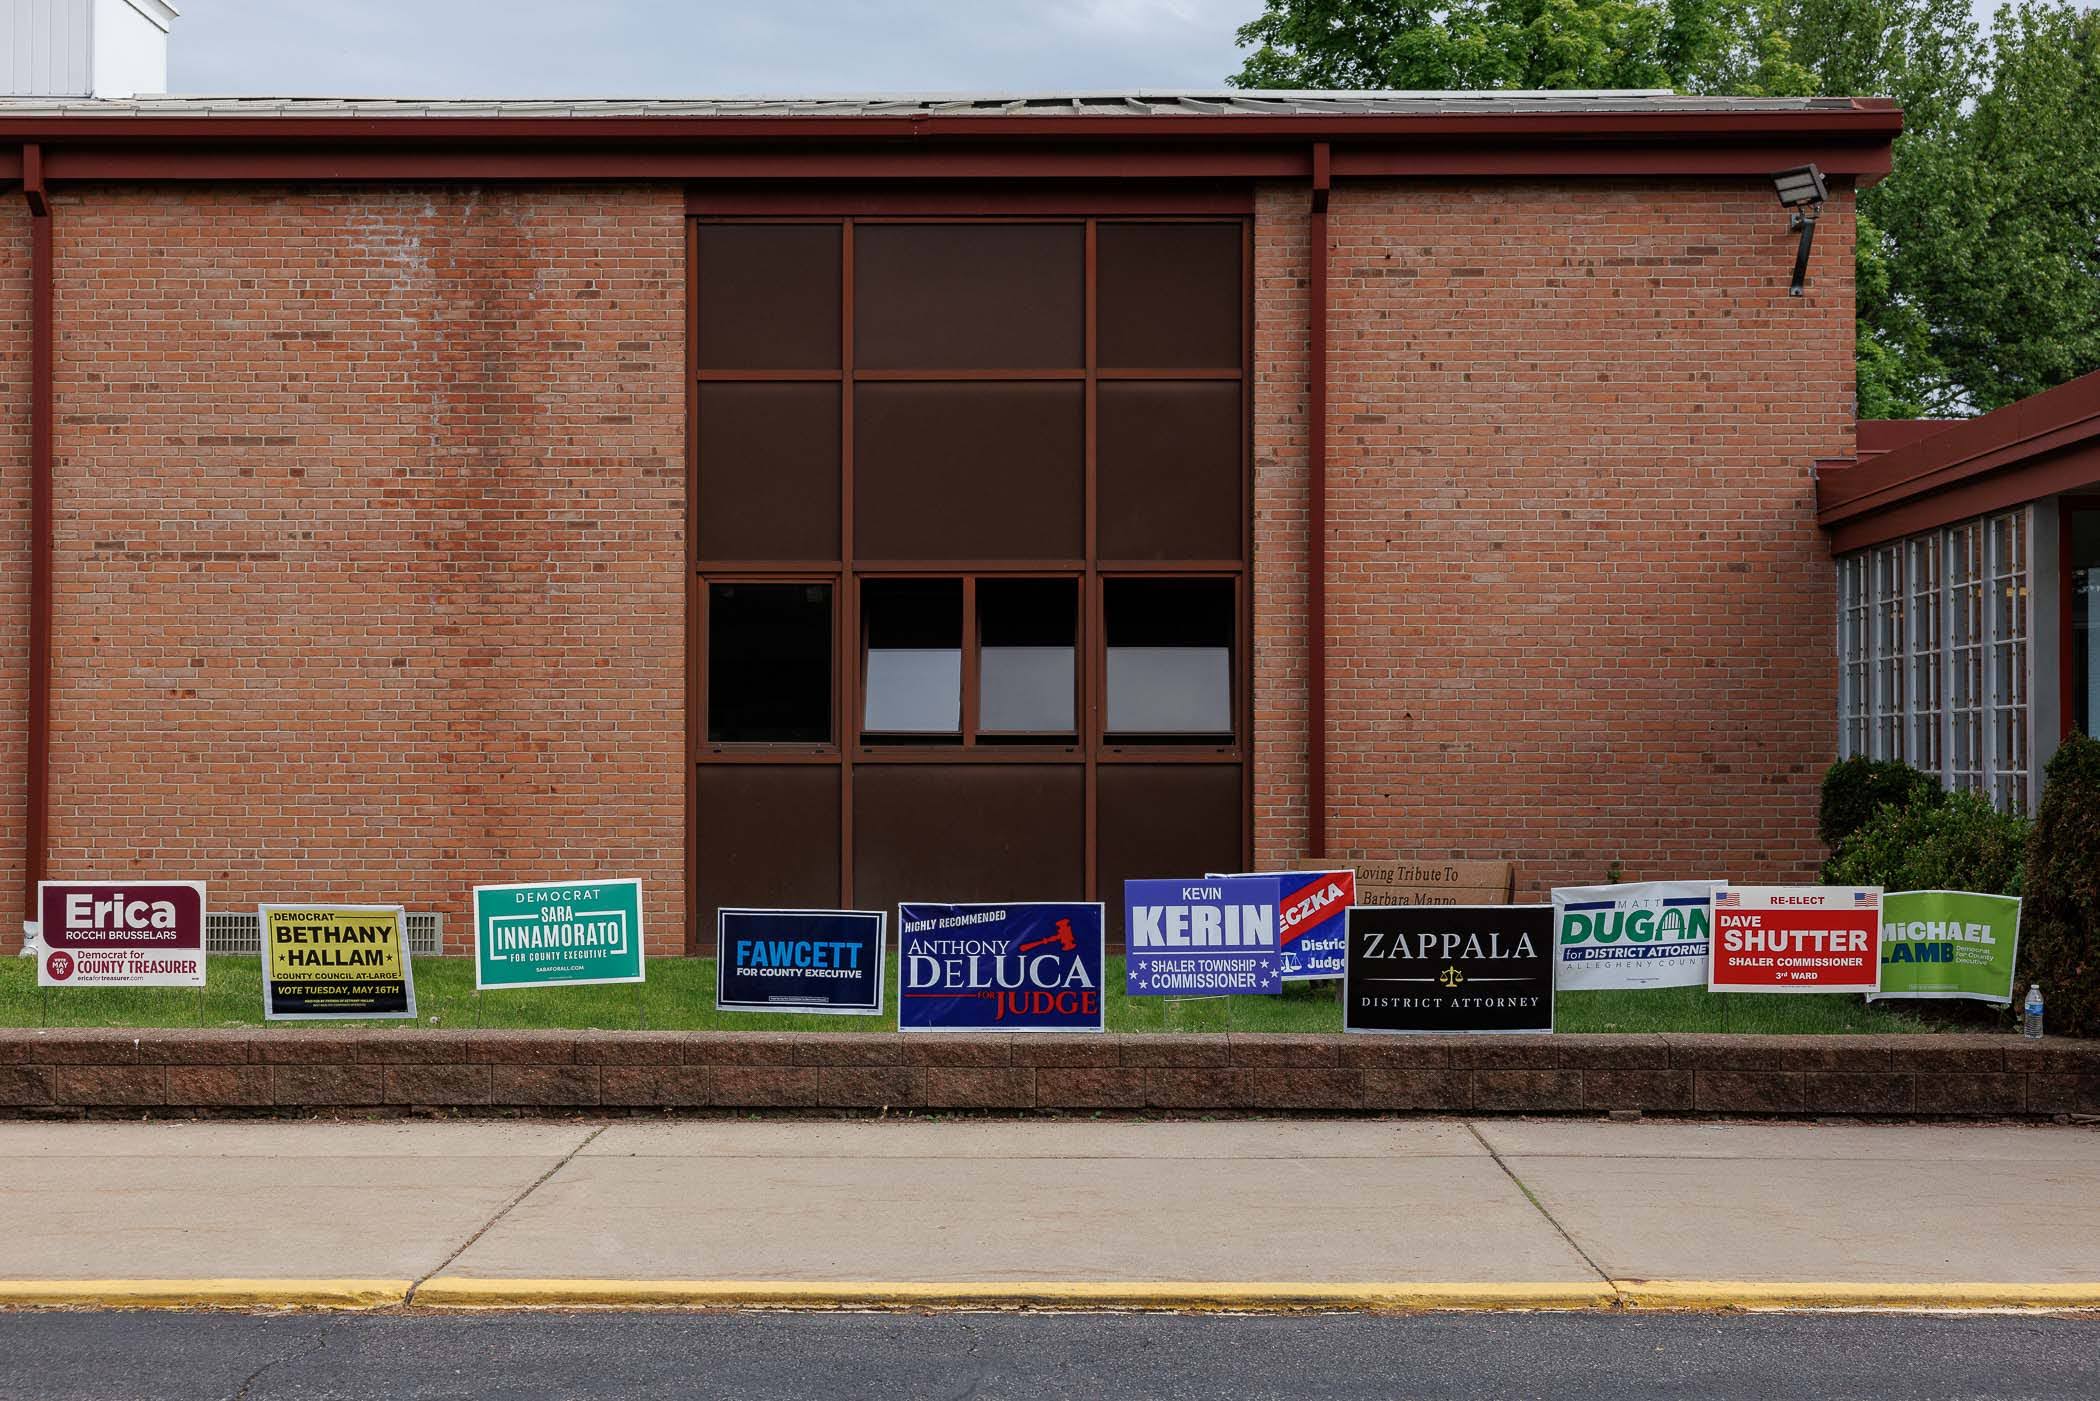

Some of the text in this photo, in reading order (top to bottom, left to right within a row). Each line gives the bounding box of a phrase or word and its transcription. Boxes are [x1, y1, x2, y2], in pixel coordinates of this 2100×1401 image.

[1356, 866, 1458, 883] Loving Tribute To
[516, 889, 600, 903] DEMOCRAT
[1182, 887, 1222, 900] KEVIN
[1364, 892, 1409, 905] Barbara
[1770, 896, 1825, 905] RE-ELECT
[66, 894, 176, 928] Erica
[1618, 899, 1661, 909] MATT
[274, 913, 335, 922] DEMOCRAT
[541, 906, 573, 922] SARA
[1720, 915, 1761, 927] DAVE
[905, 910, 1006, 933] HIGHLY RECOMMENDED
[1132, 904, 1273, 946] KERIN
[1560, 908, 1710, 945] DUGAN
[66, 931, 176, 940] ROCCHI BRUSSELARS
[276, 926, 392, 944] BETHANY
[497, 922, 618, 950] INNAMORATO
[1723, 929, 1868, 952] SHUTTER
[908, 938, 1010, 954] ANTHONY
[1301, 938, 1345, 951] Distric
[1363, 932, 1538, 959] ZAPPALA
[1956, 946, 1990, 954] Democrat
[78, 951, 144, 959] Democrat for
[288, 950, 384, 966] HALLAM
[510, 949, 607, 962] FOR COUNTY EXECUTIVE
[736, 940, 863, 968] FAWCETT
[1566, 945, 1709, 960] for DISTRICT ATTORNE
[1968, 952, 1994, 961] County
[78, 960, 197, 974] COUNTY TREASURER
[1151, 959, 1256, 973] SHALER TOWNSHIP
[1566, 958, 1705, 970] ALLEGHENY COUNT
[1728, 957, 1863, 966] SHALER COMMISSIONER
[736, 968, 862, 978] FOR COUNTY EXECUTIVE
[1775, 972, 1818, 980] 3rd WARD
[1151, 973, 1256, 989] COMMISSIONER
[278, 986, 399, 995] VOTE TUESDAY, MAY 16TH
[995, 991, 1098, 1020] JUDGE
[1362, 997, 1539, 1008] DISTRICT ATTORNEY
